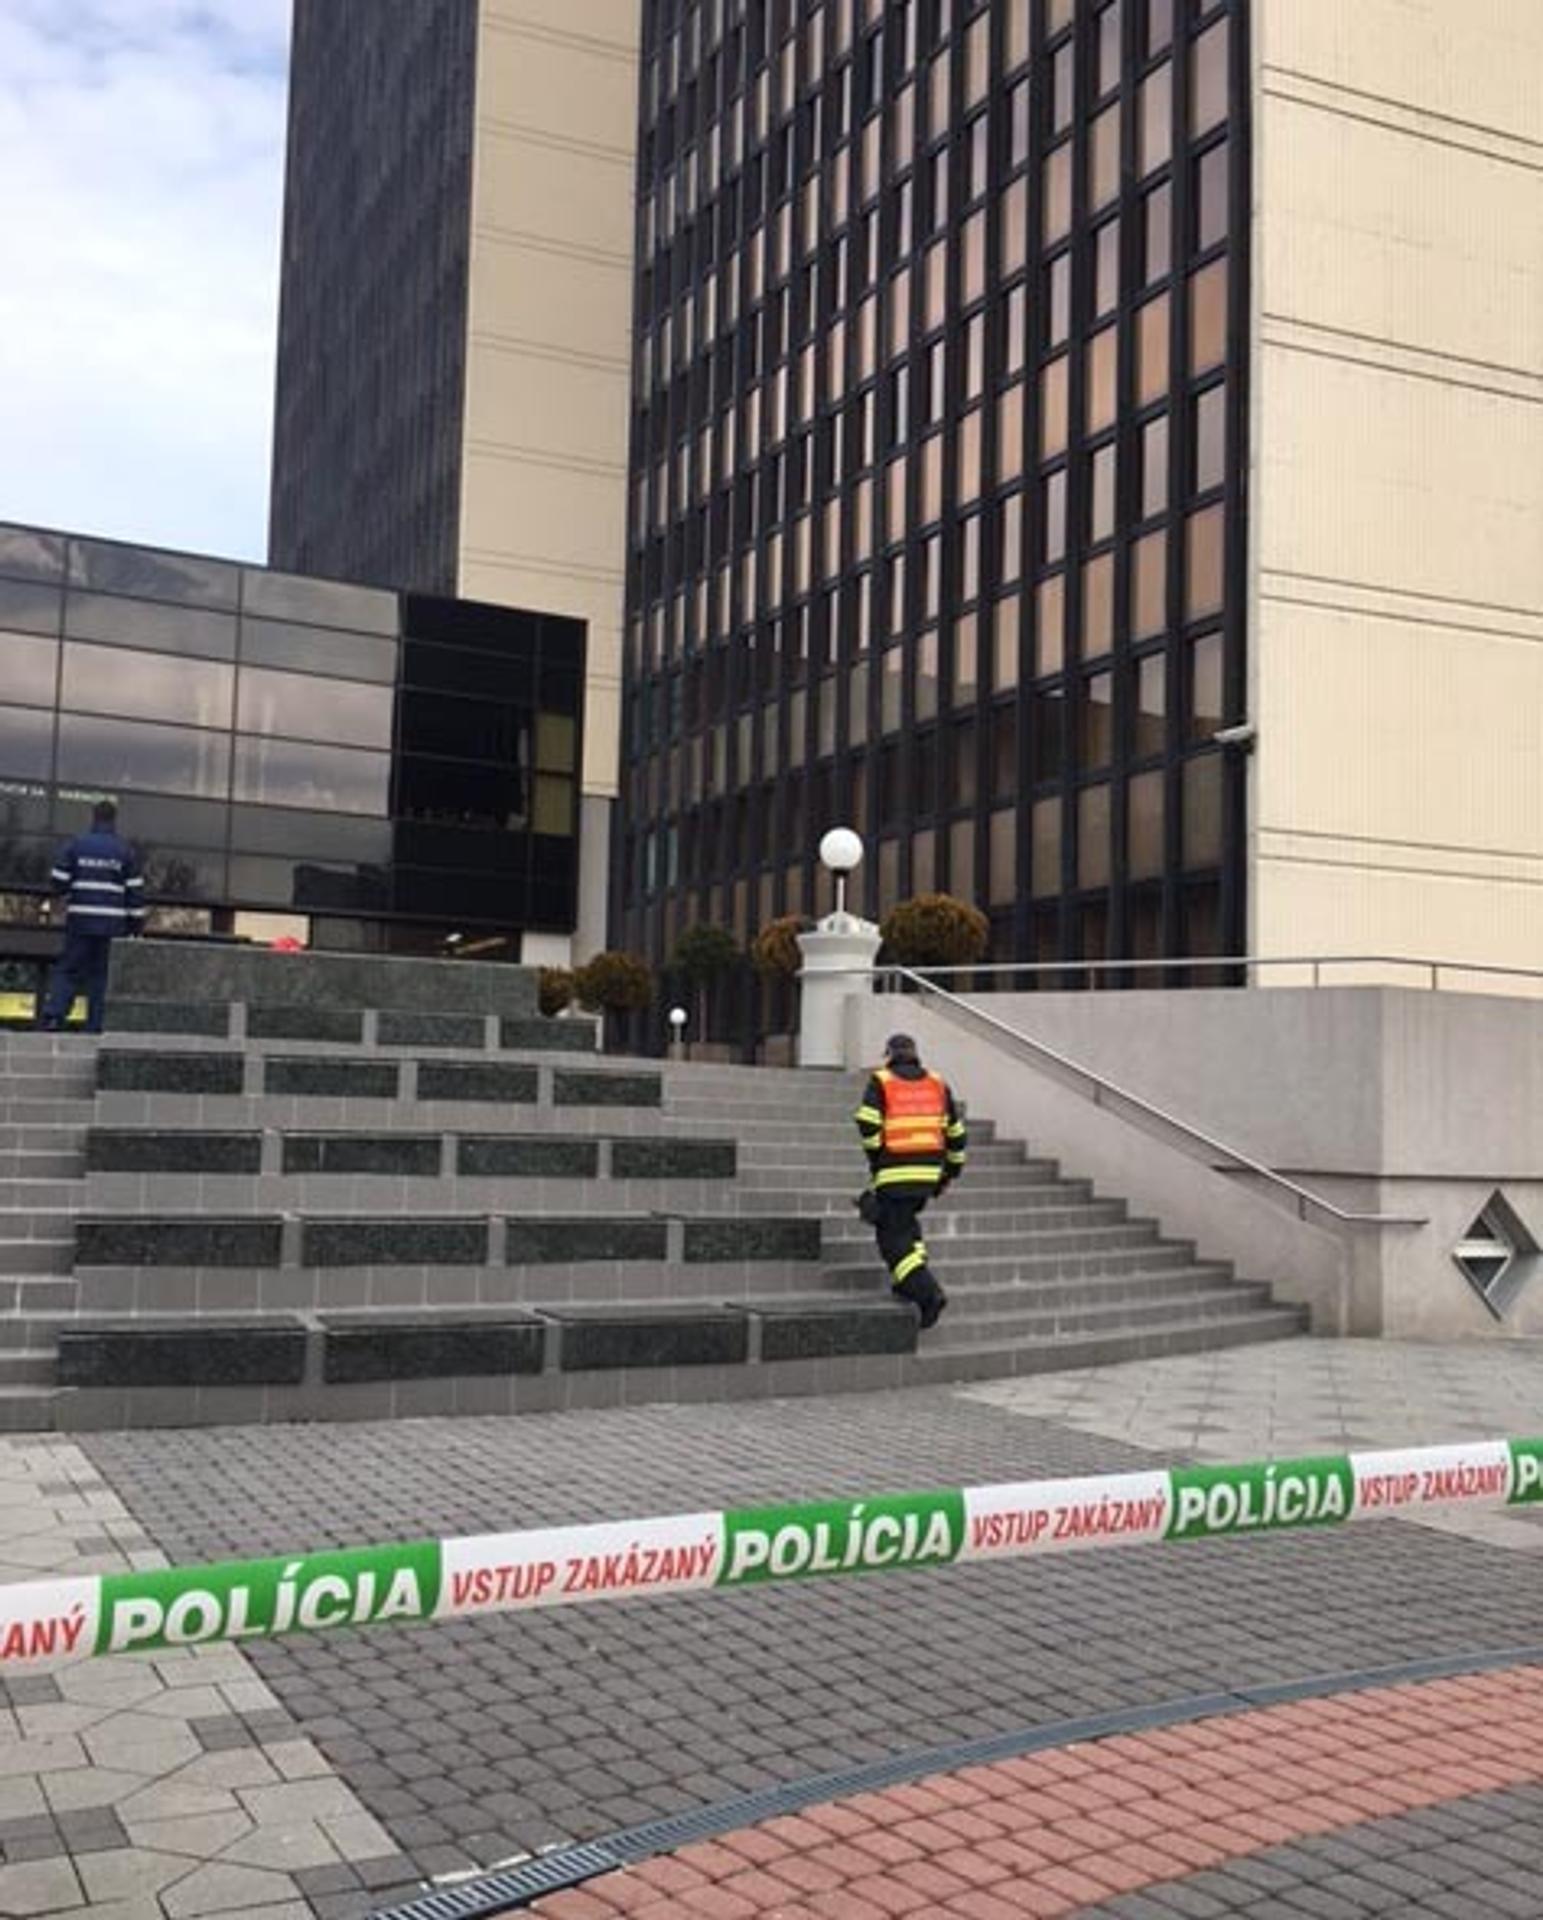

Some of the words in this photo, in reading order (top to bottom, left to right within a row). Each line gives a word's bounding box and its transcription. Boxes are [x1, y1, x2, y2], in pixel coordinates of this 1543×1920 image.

[1175, 1466, 1345, 1533] POLÍCIA
[1360, 1473, 1418, 1507] VSTUP
[1422, 1457, 1507, 1501] ZAKÁZANÝ
[1516, 1453, 1543, 1496] P
[729, 1504, 954, 1580] POLÍCIA
[972, 1510, 1049, 1549] VSTUP
[1053, 1488, 1166, 1539] ZAKÁZANÝ
[452, 1561, 555, 1606] VSTUP
[561, 1534, 716, 1593] ZAKÁZANÝ
[109, 1563, 423, 1650] POLÍCIA
